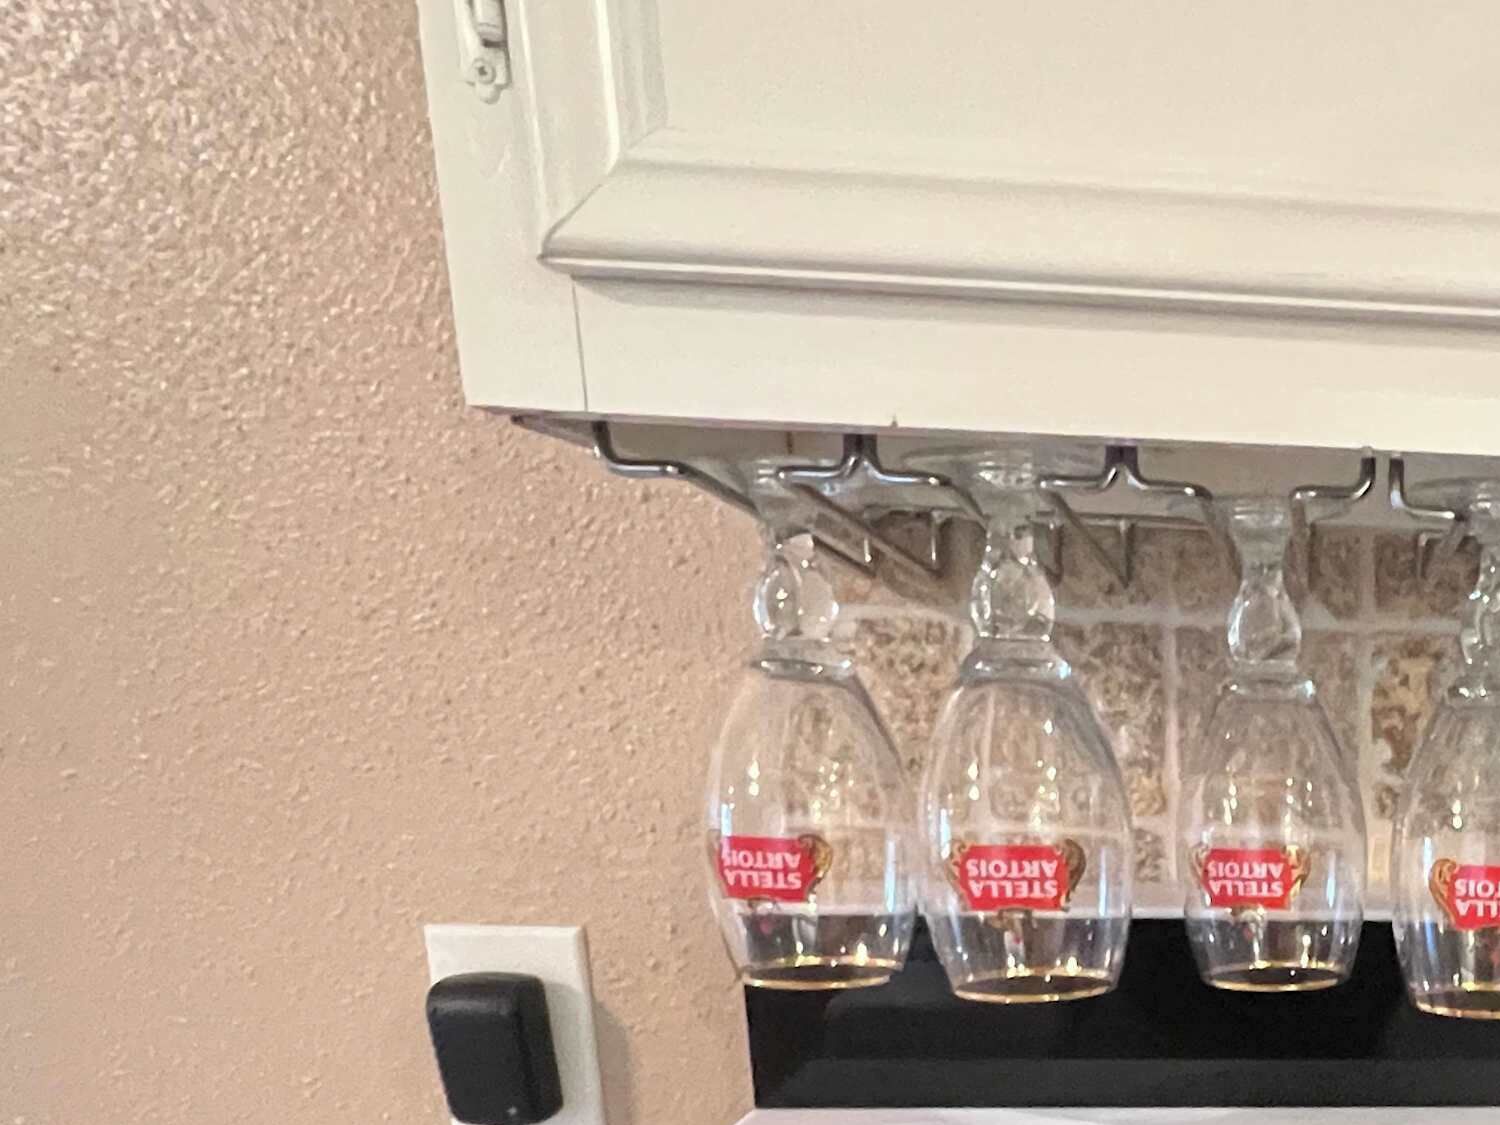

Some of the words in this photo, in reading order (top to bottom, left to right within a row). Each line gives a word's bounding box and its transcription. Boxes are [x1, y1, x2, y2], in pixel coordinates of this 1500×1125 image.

[965, 858, 1058, 878] ARTOIS
[1207, 860, 1284, 879] ARTOIS
[723, 867, 802, 889] STELLA
[968, 879, 1058, 898] STELLA
[1208, 879, 1284, 897] STELLA
